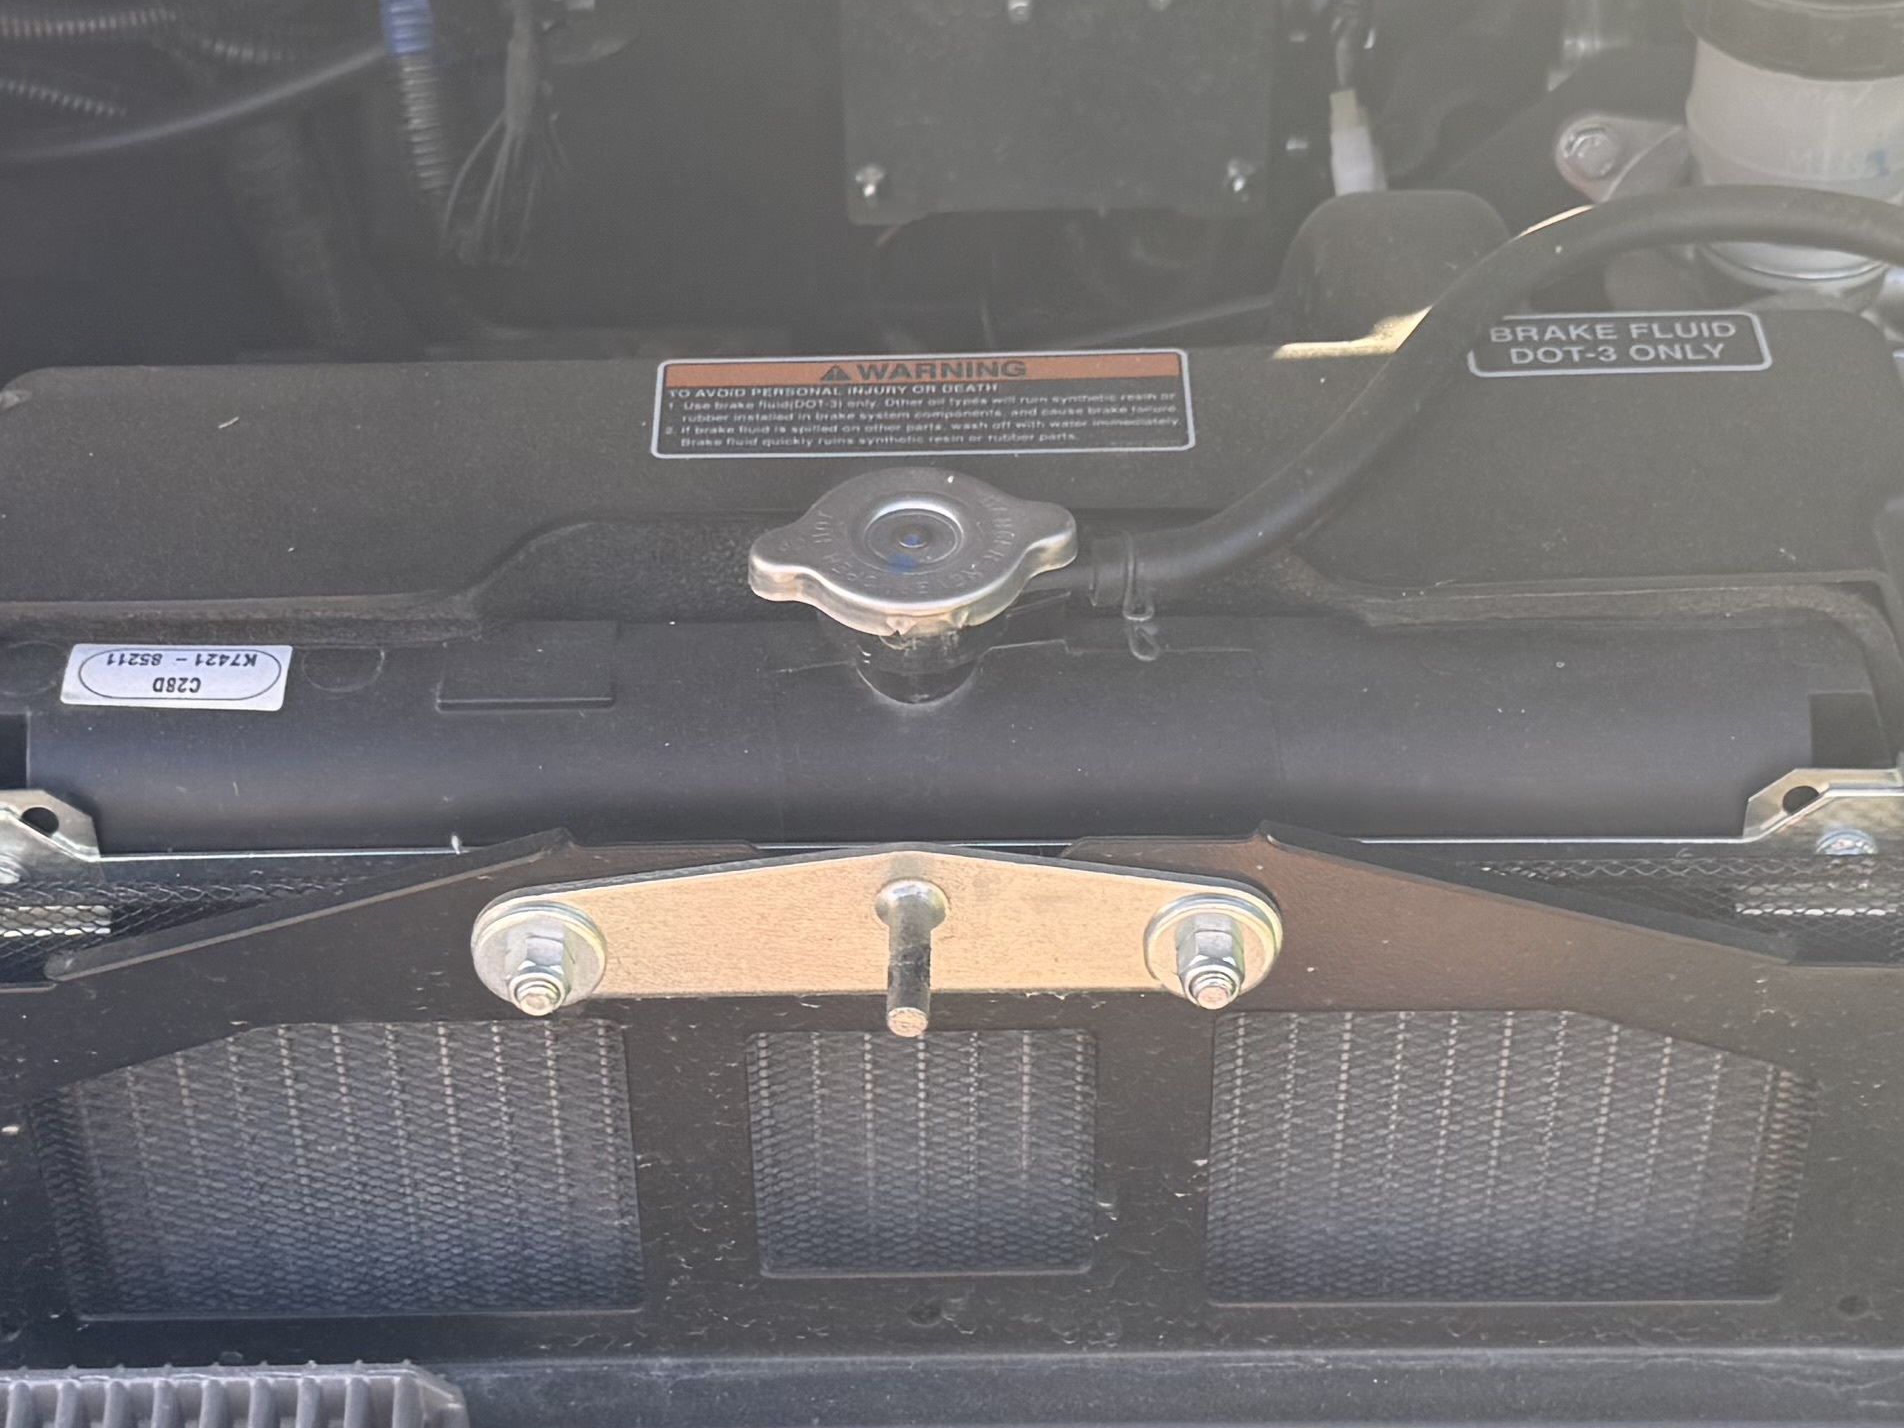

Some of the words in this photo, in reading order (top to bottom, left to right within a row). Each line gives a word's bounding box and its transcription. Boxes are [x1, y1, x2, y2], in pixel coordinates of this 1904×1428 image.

[1490, 323, 1617, 343] BRAKE
[1630, 321, 1737, 339] FLUID
[1510, 345, 1617, 364] DOT-3
[1629, 343, 1724, 362] ONLY
[856, 359, 1027, 381] WARNING
[669, 388, 691, 398] TO
[695, 388, 746, 398] AVOID
[752, 386, 842, 397] PERSONAL
[848, 384, 907, 396] INJURY
[912, 384, 936, 394] OR
[942, 383, 998, 393] DEATH
[106, 652, 163, 667] 85211
[195, 652, 258, 667] K7421
[152, 676, 201, 693] C28D
